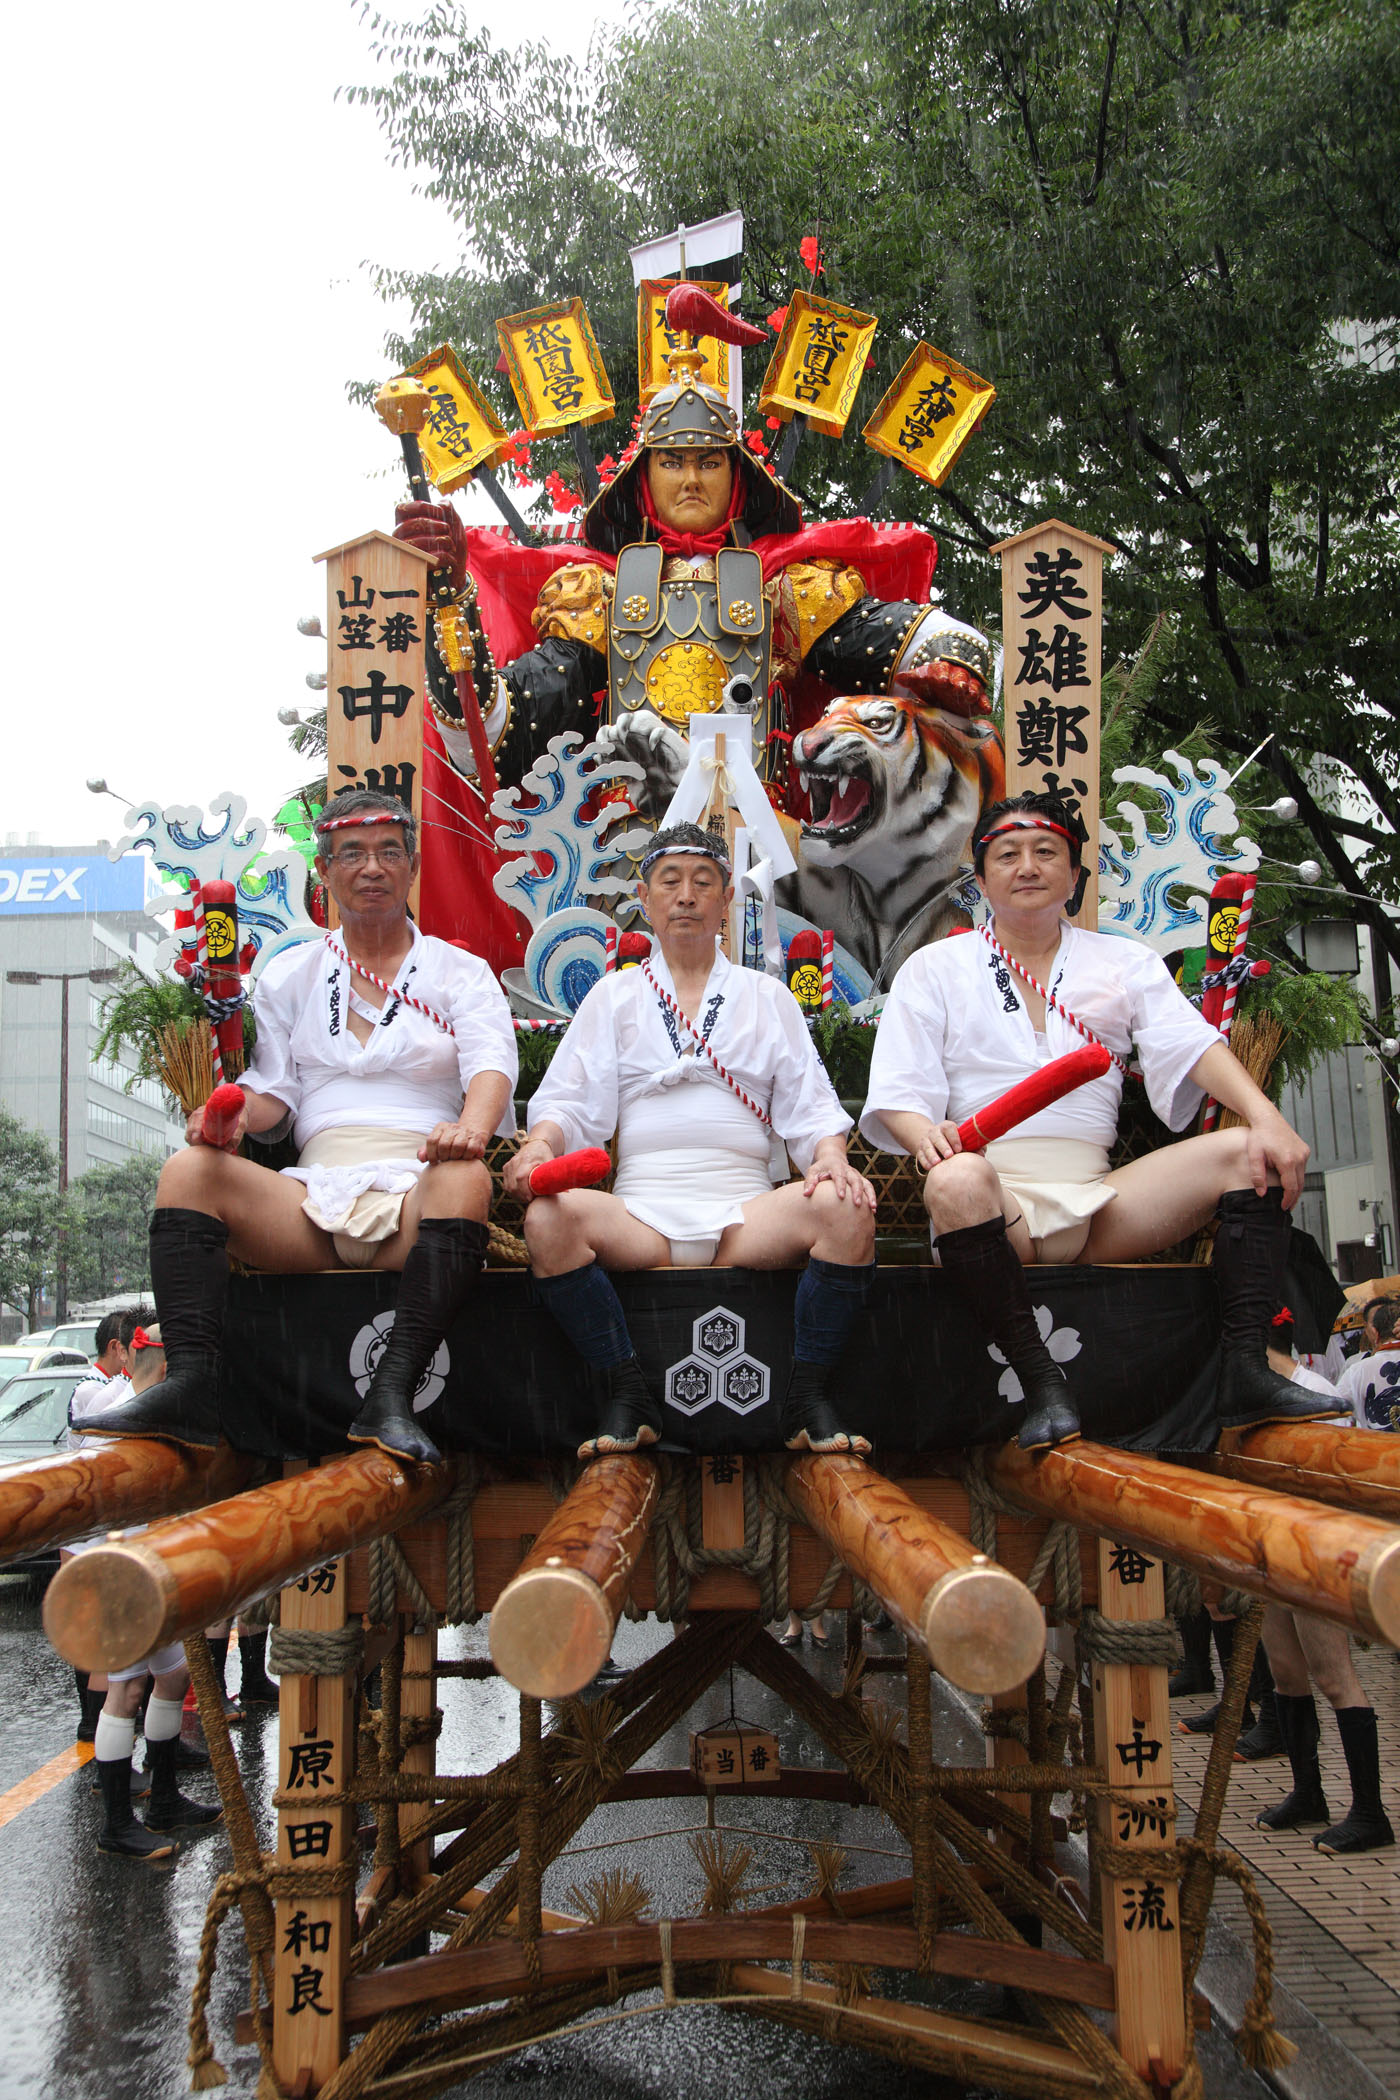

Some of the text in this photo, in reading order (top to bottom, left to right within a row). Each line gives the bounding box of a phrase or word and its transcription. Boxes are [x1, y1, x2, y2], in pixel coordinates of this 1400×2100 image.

[1014, 547, 1093, 917] 英雄鄭
[716, 1745, 771, 1775] 当番
